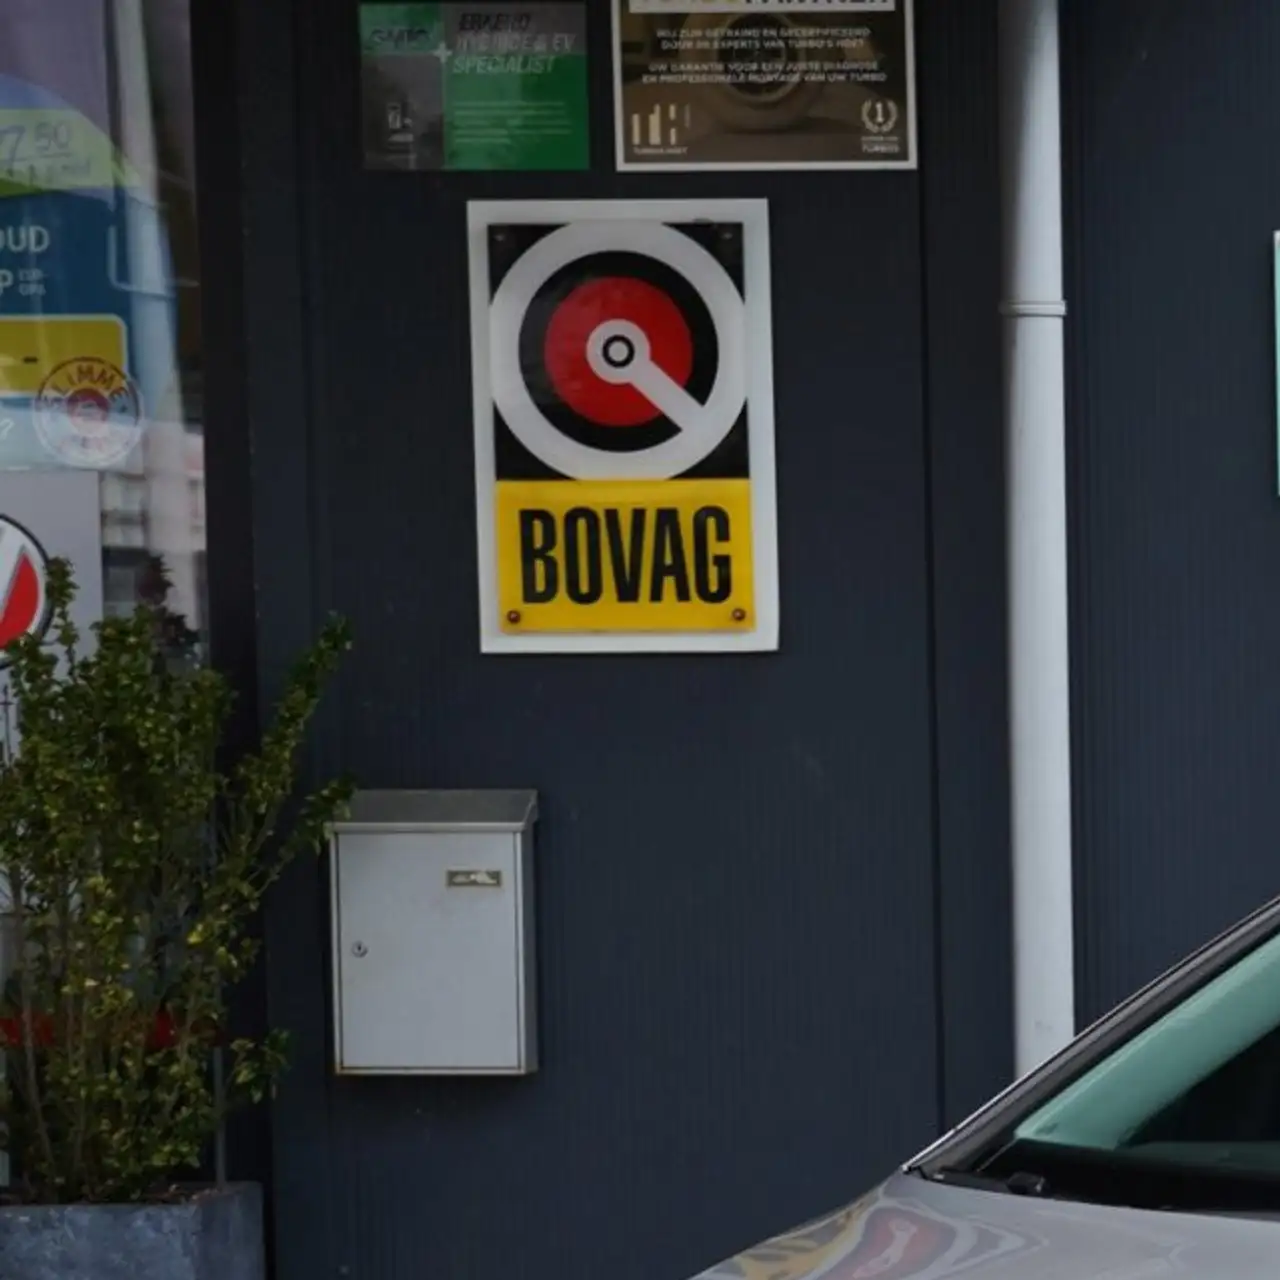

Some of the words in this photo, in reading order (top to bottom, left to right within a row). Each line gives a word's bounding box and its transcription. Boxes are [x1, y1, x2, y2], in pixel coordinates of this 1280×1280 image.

[552, 32, 577, 52] EV
[713, 39, 760, 49] EXPERTS
[762, 39, 785, 48] VAN
[453, 55, 557, 74] SPECIALIST
[518, 505, 732, 605] BOVAG
